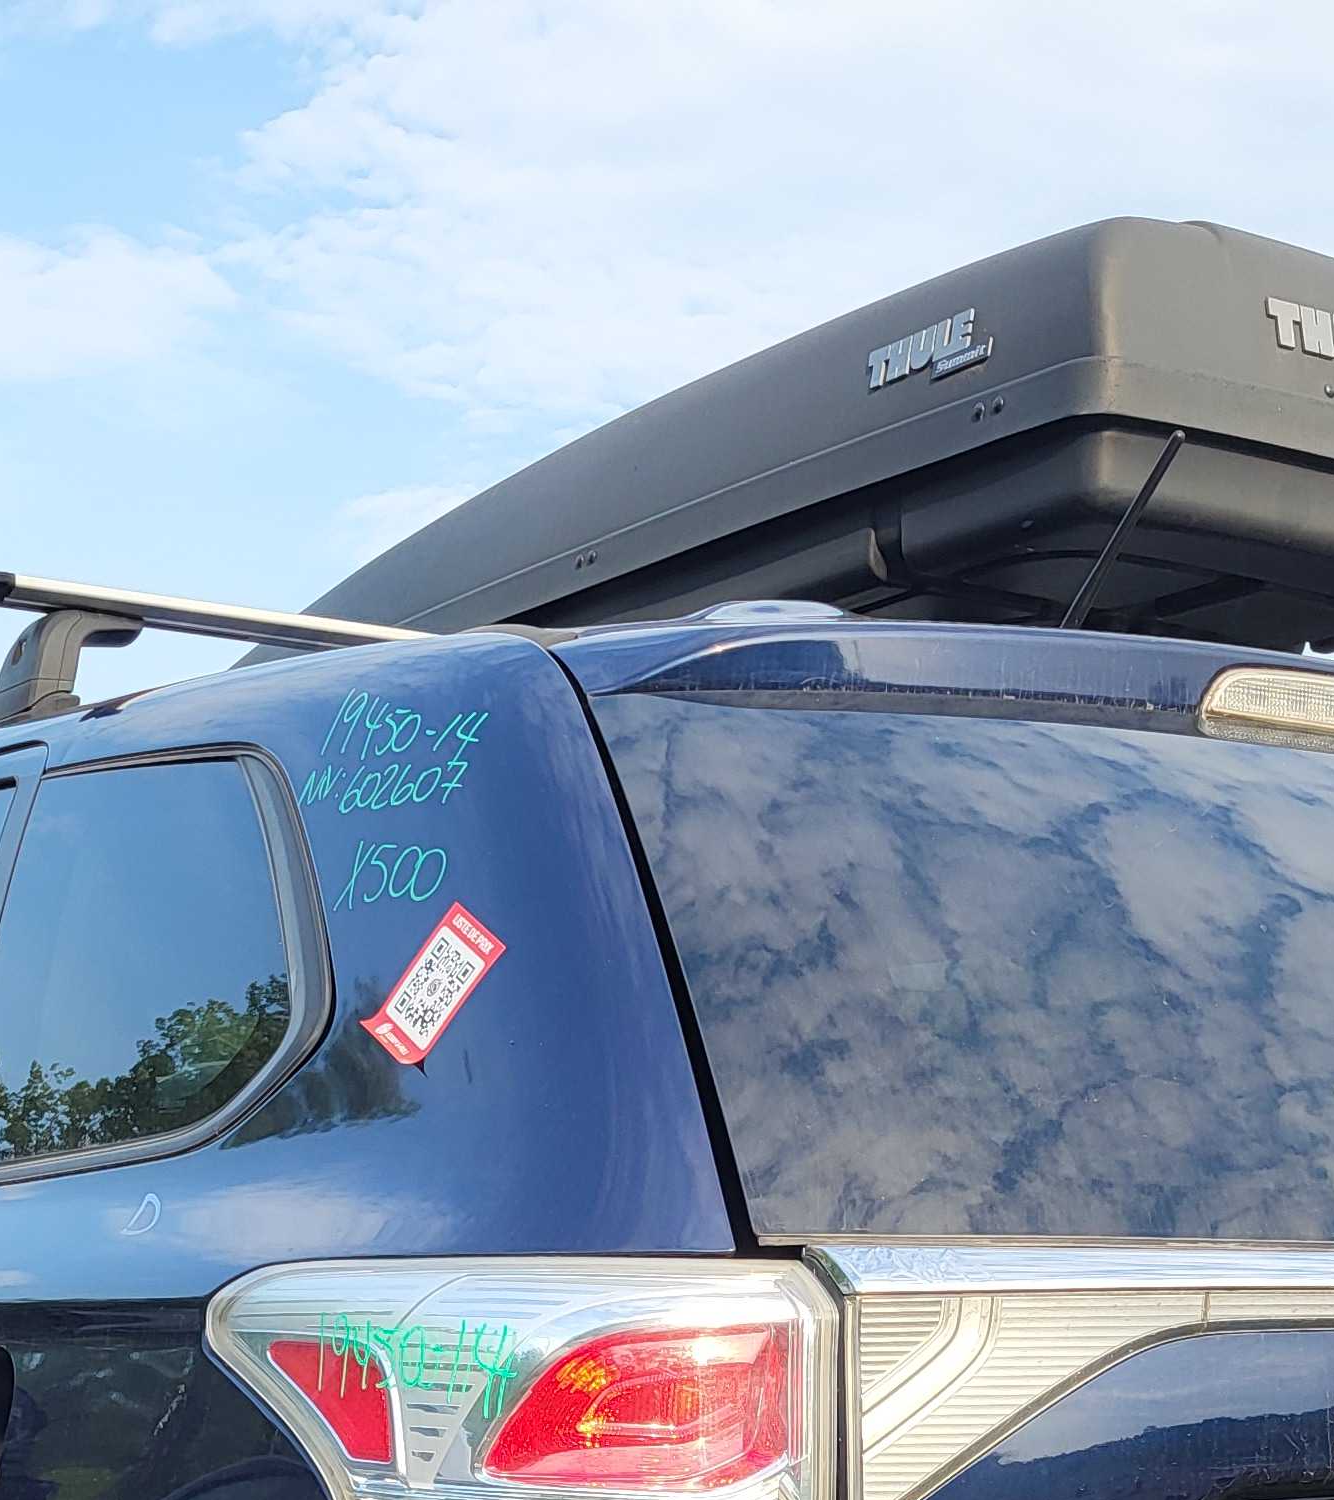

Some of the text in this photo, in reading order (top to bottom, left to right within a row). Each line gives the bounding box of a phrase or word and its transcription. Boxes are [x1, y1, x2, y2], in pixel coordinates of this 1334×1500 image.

[867, 308, 975, 389] THULE
[935, 344, 987, 374] Summit
[321, 687, 489, 764] 19450-14
[333, 840, 447, 912] X500
